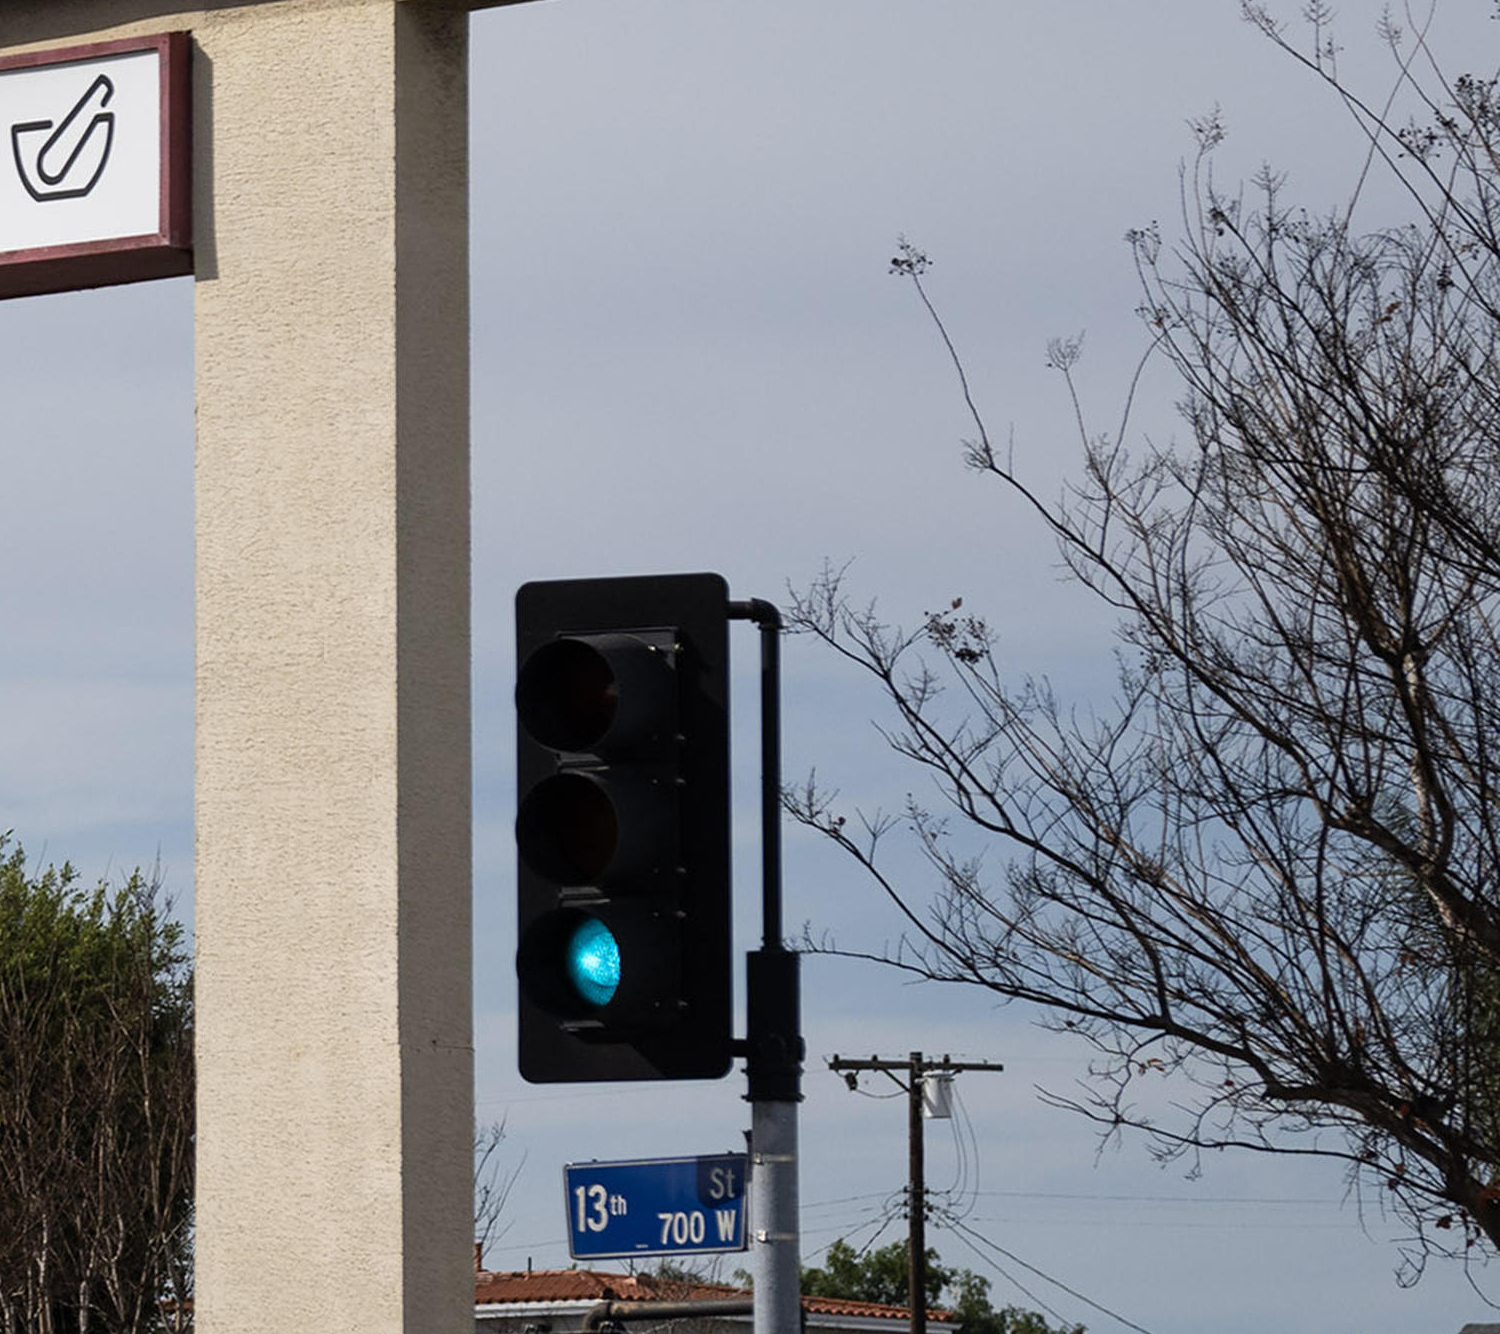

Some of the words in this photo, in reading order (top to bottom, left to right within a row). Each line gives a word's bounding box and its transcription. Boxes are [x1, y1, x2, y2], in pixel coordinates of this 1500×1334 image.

[575, 1183, 628, 1233] 13th
[709, 1167, 736, 1200] St
[657, 1210, 706, 1245] 700
[715, 1209, 737, 1243] W
